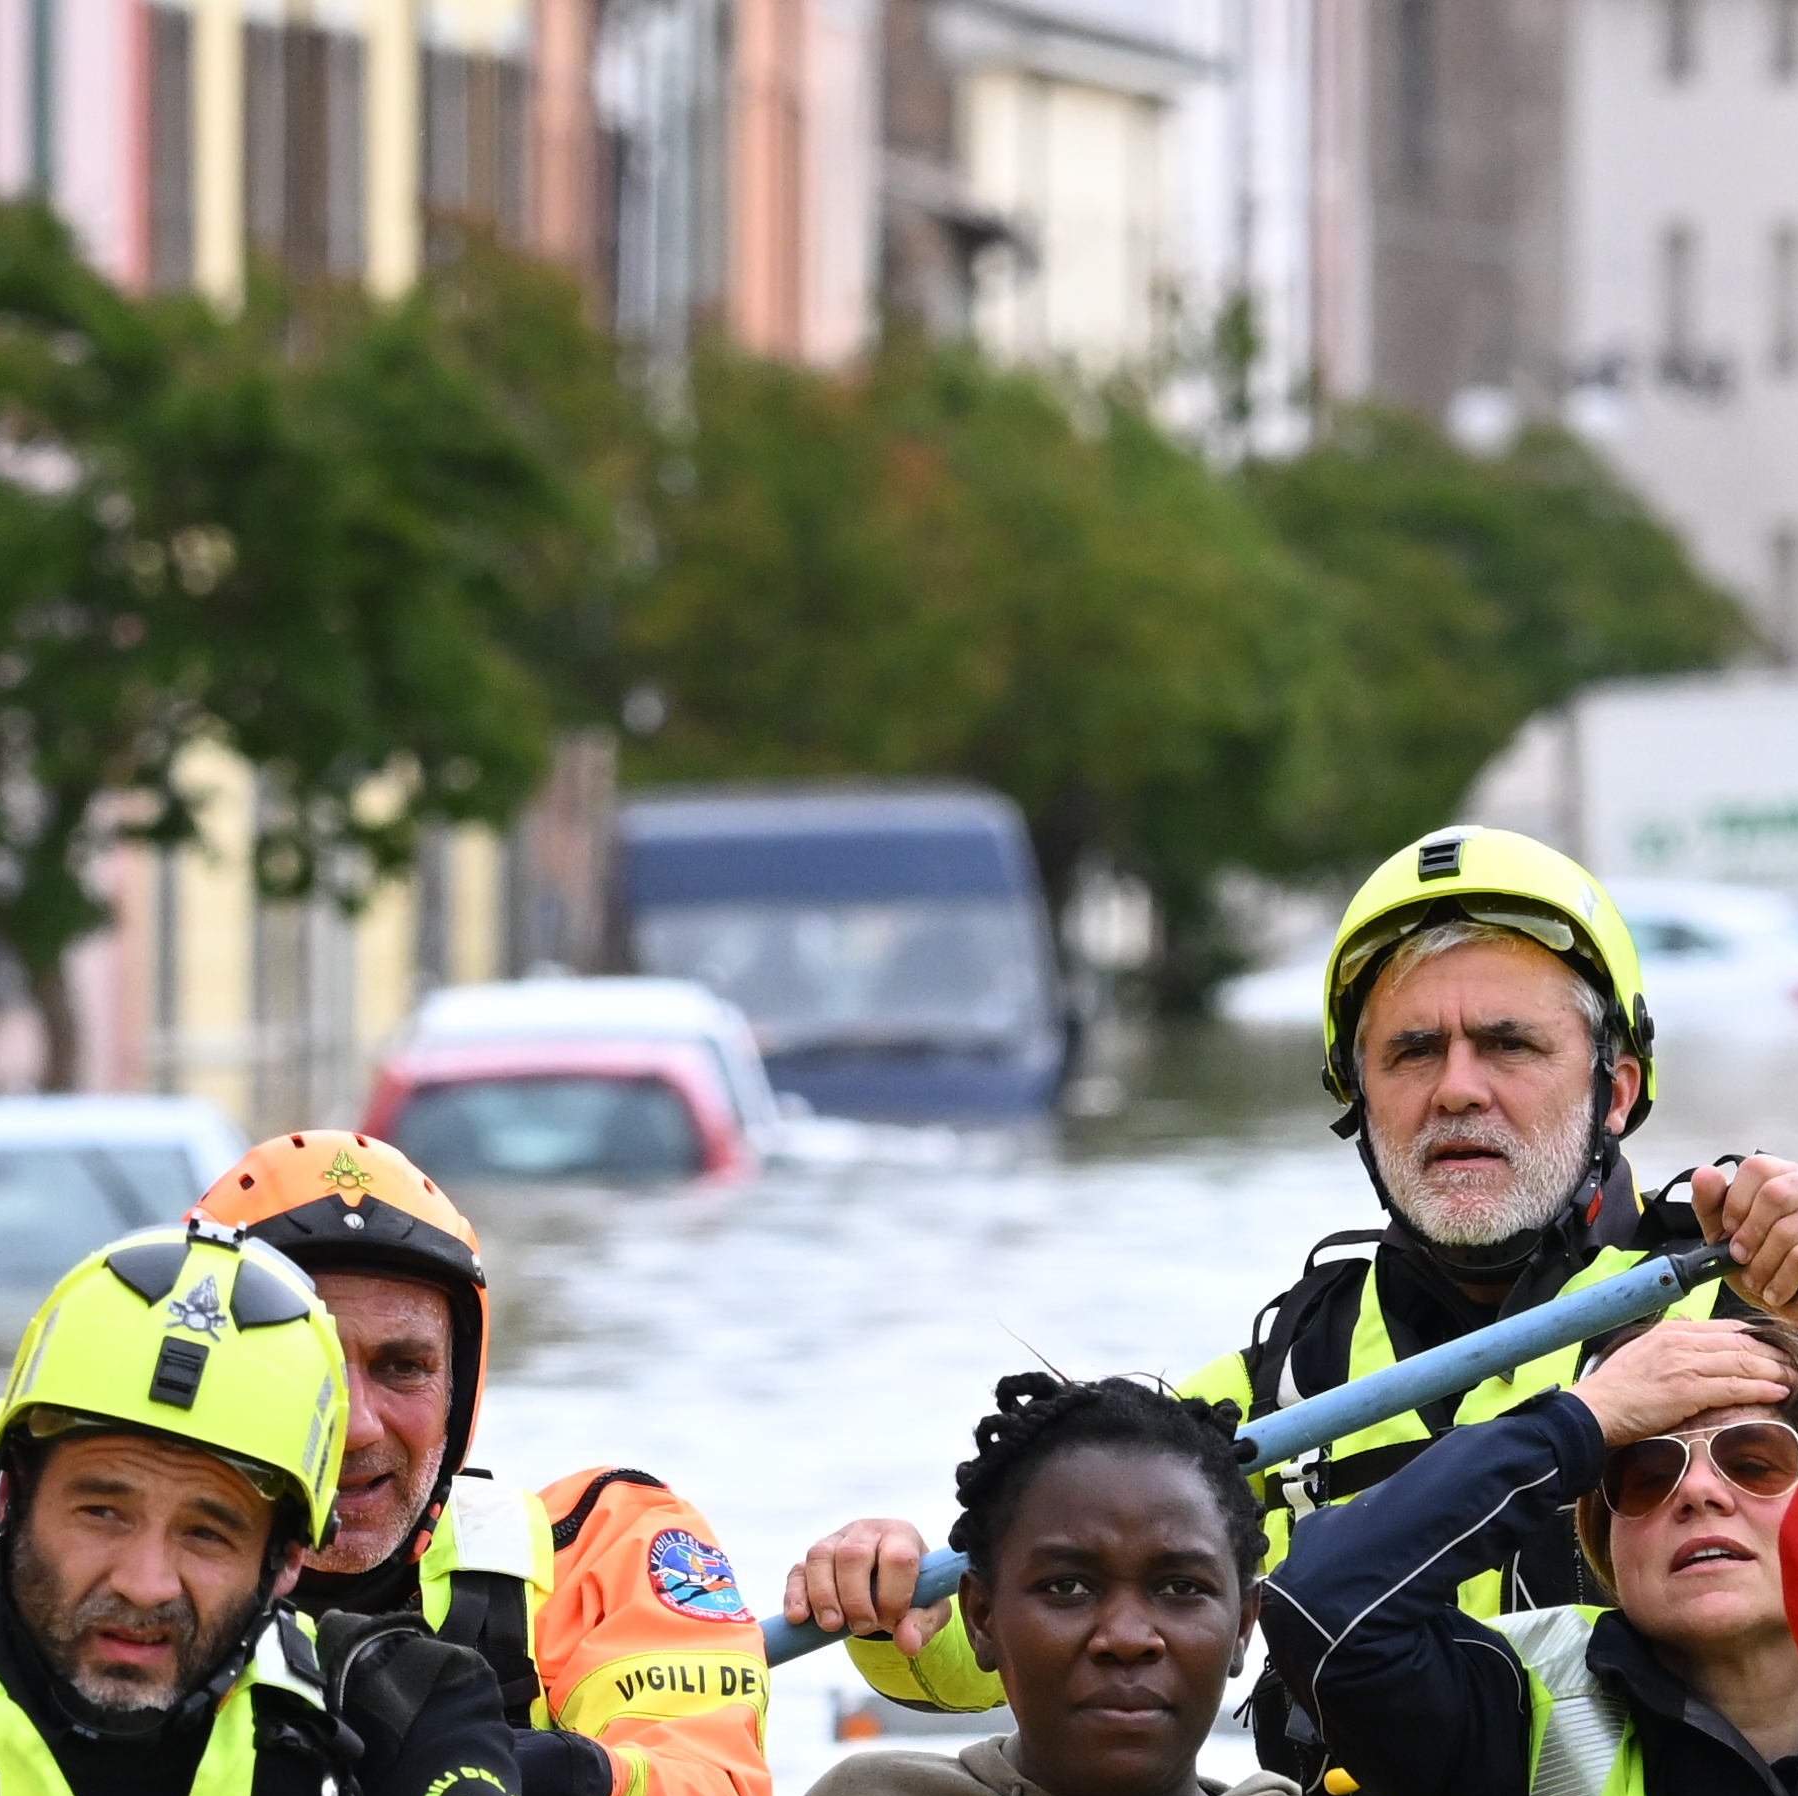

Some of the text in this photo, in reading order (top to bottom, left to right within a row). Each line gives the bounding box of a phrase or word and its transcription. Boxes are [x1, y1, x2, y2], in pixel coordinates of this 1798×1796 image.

[650, 1531, 703, 1565] VIGILI DEL
[615, 1665, 706, 1702] VIGILI
